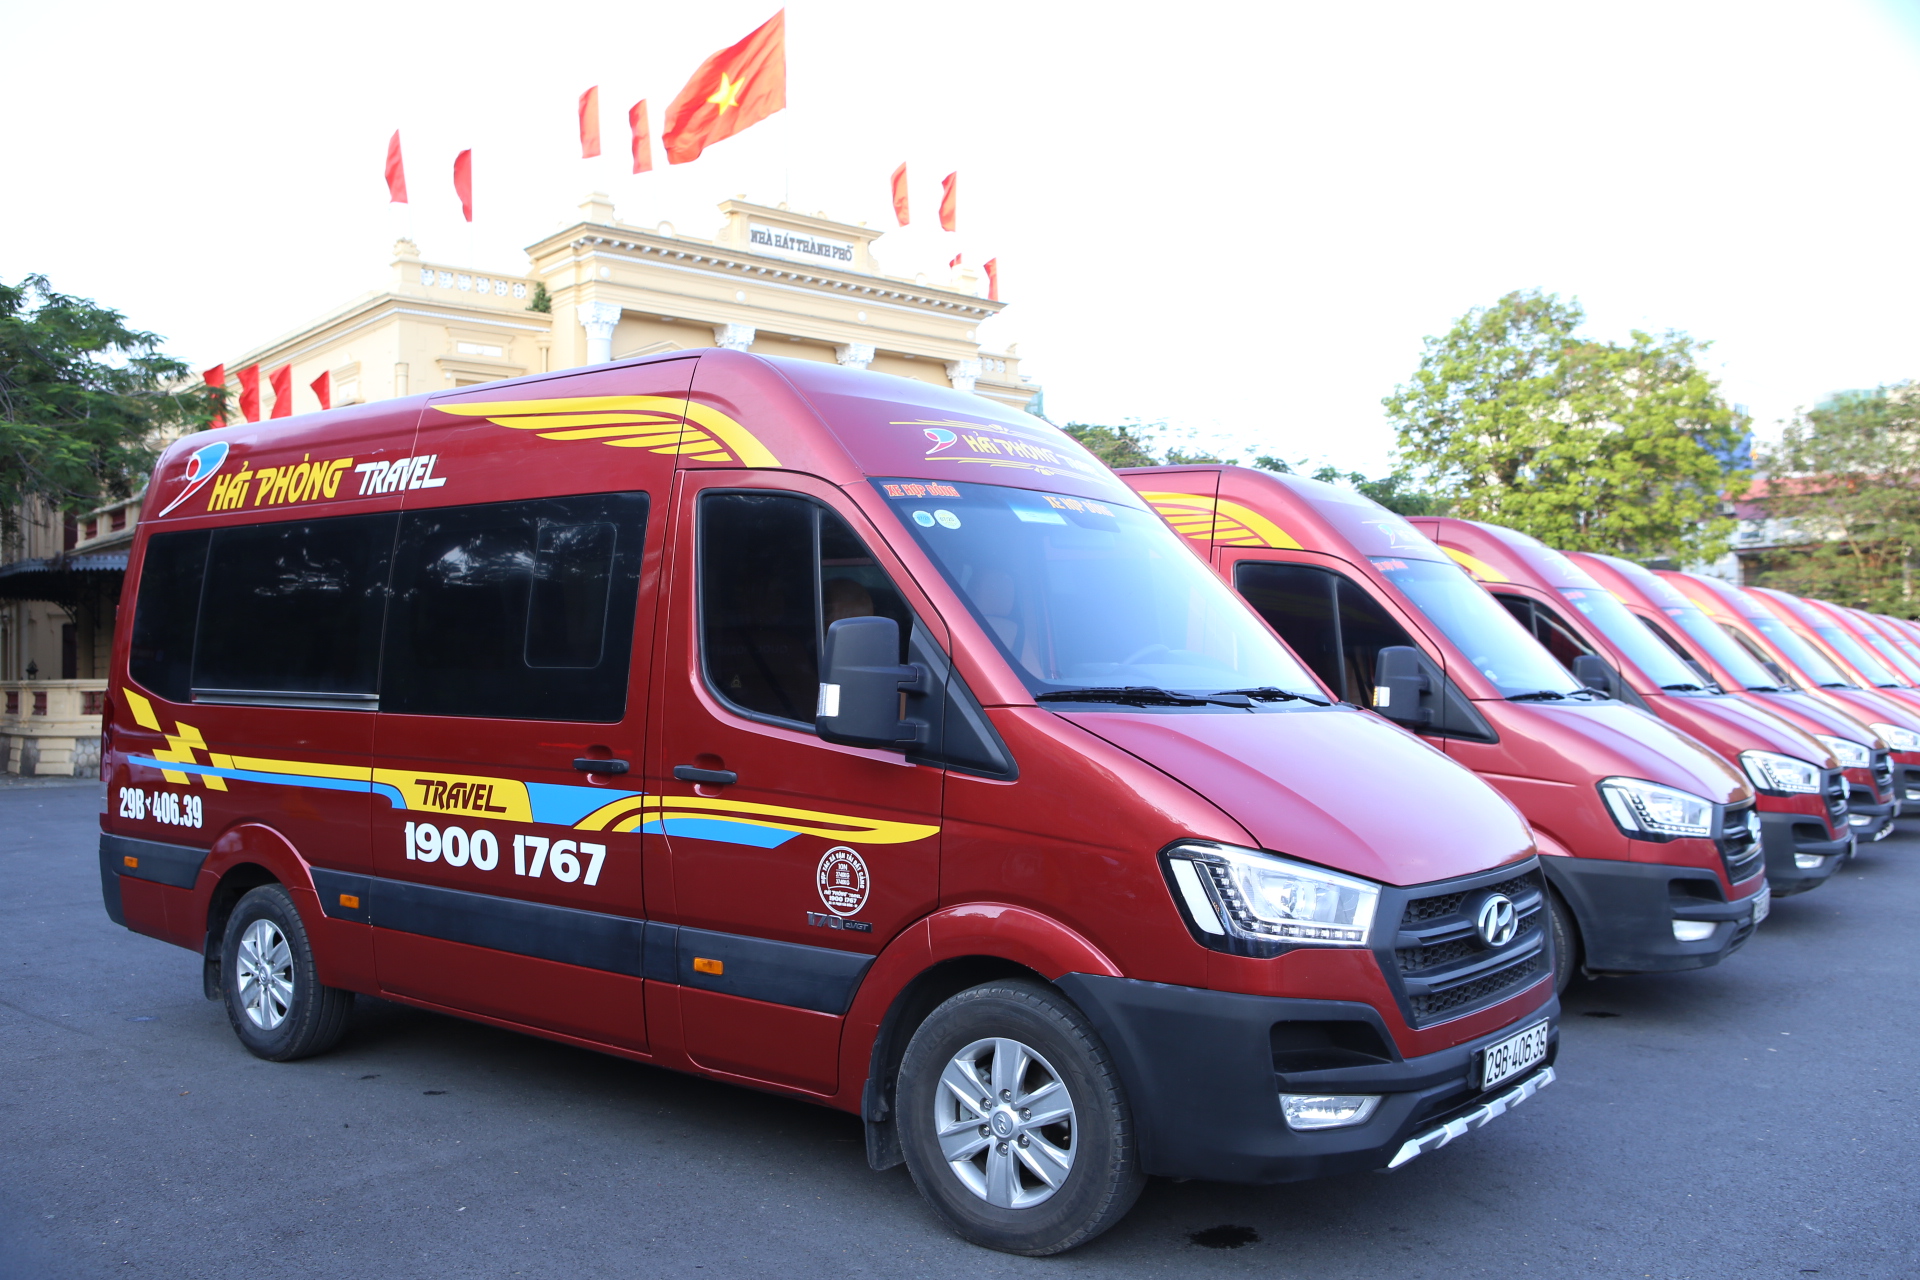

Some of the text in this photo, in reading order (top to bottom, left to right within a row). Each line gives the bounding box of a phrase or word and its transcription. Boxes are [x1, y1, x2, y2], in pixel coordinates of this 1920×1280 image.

[751, 228, 772, 246] NHÀ
[775, 233, 795, 250] HÁT
[796, 237, 831, 258] THÀNH
[961, 431, 1002, 454] HẢI
[207, 461, 254, 511] HẢI
[354, 454, 447, 495] TRAVEL
[883, 484, 905, 497] XE
[414, 778, 507, 813] TRAVEL
[404, 821, 607, 886] 1900 1767
[1486, 1026, 1546, 1084] 29B-406.39
